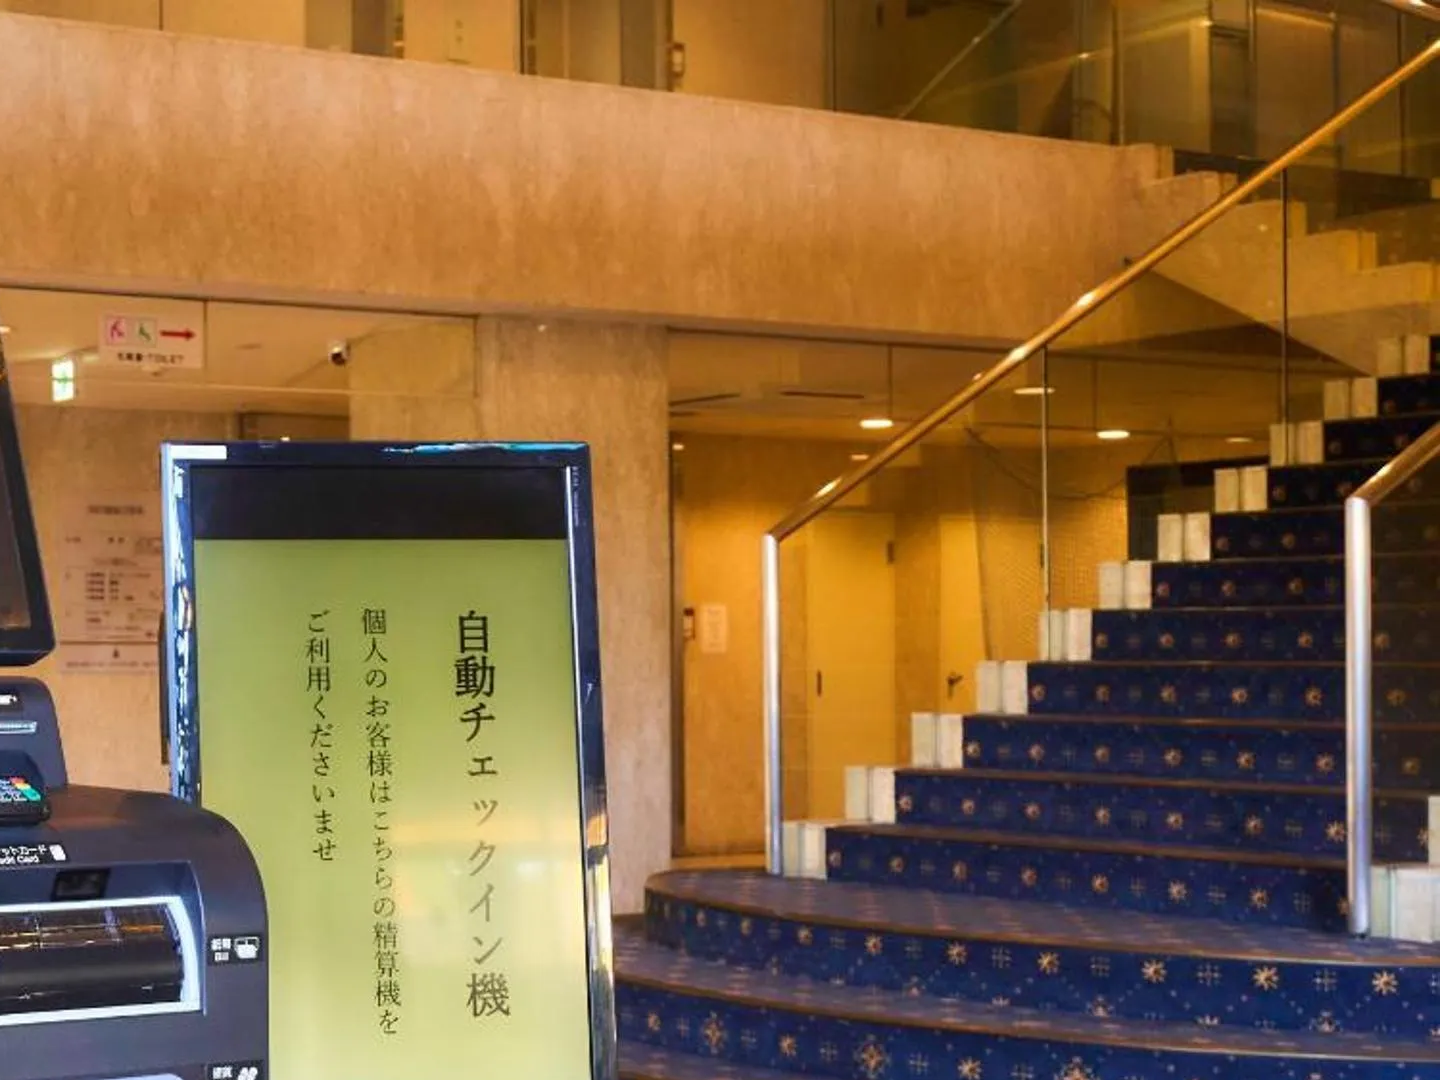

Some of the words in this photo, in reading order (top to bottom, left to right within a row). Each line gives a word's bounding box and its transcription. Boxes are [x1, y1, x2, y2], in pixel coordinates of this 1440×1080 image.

[305, 610, 338, 862] ご利用くださいませ
[362, 608, 402, 1036] 個人のお客様はこちらの精算機を
[454, 609, 511, 1018] 自動チェックイン機
